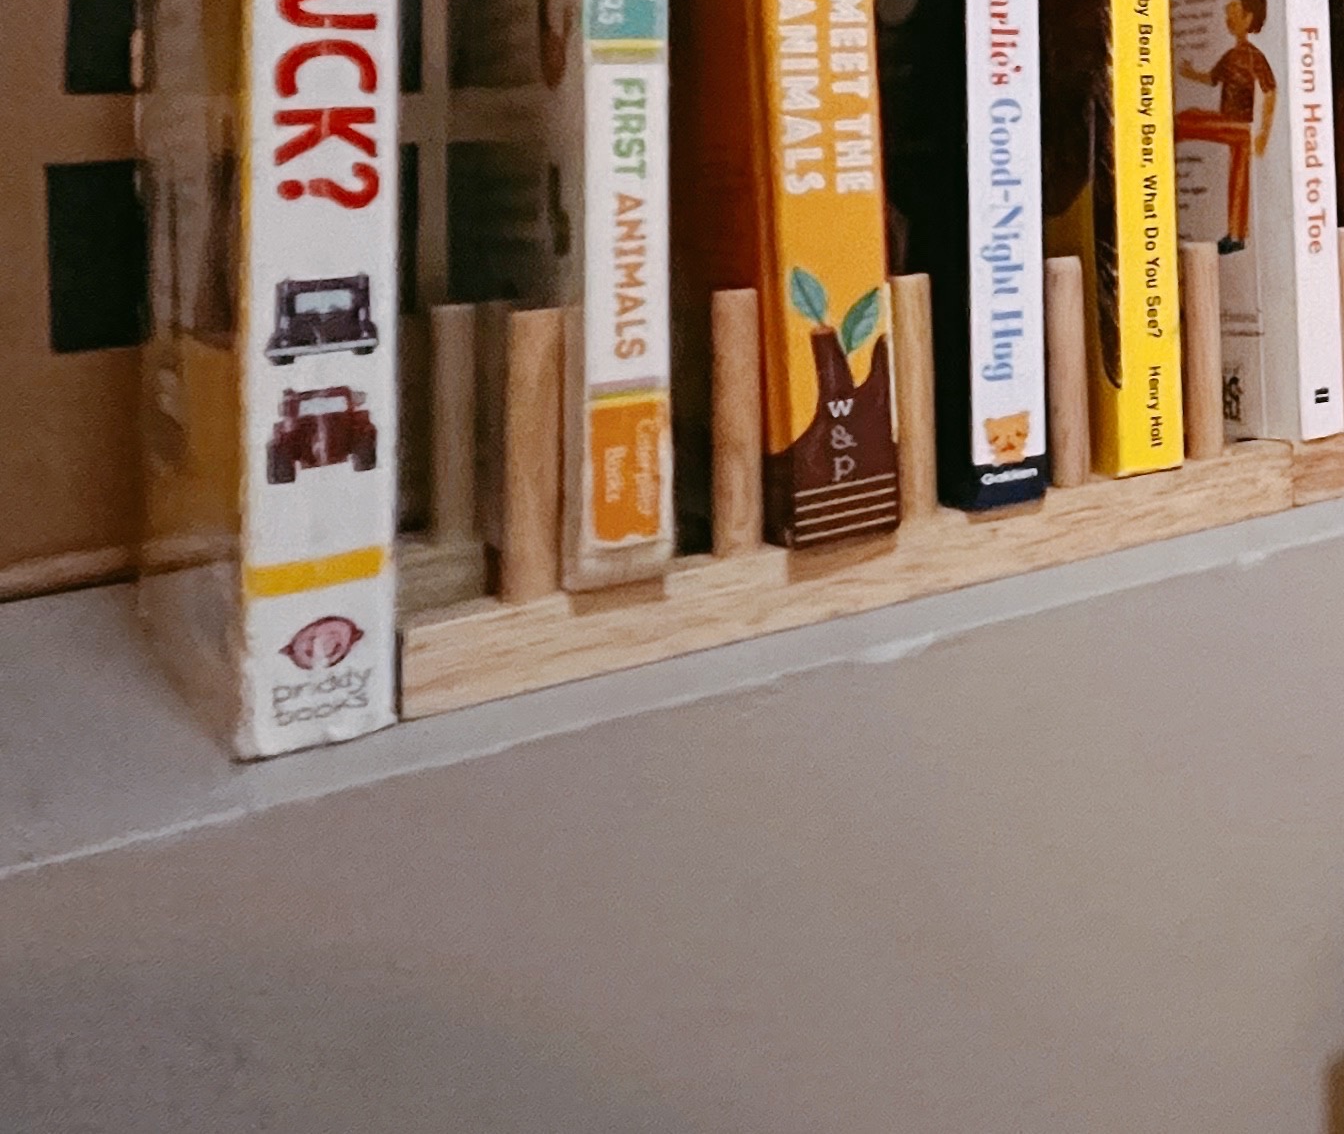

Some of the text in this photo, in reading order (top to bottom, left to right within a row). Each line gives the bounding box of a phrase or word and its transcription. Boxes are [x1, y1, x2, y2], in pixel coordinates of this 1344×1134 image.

[1135, 23, 1153, 69] Bear,
[1299, 25, 1320, 94] From
[1136, 75, 1155, 118] Baby
[832, 113, 875, 196] THE
[1138, 123, 1156, 168] Bear,
[1302, 102, 1324, 166] Head
[981, 97, 1025, 297] Good-Night
[1141, 174, 1159, 220] What
[1305, 177, 1322, 204] to
[612, 76, 649, 361] FIRST ANIMALS
[1143, 226, 1160, 252] Do
[1307, 209, 1327, 255] Toe
[1143, 256, 1161, 292] You
[1145, 296, 1163, 340] See?
[981, 309, 1025, 383] Hug
[1146, 364, 1165, 413] Henry
[272, 666, 373, 707] priddy
